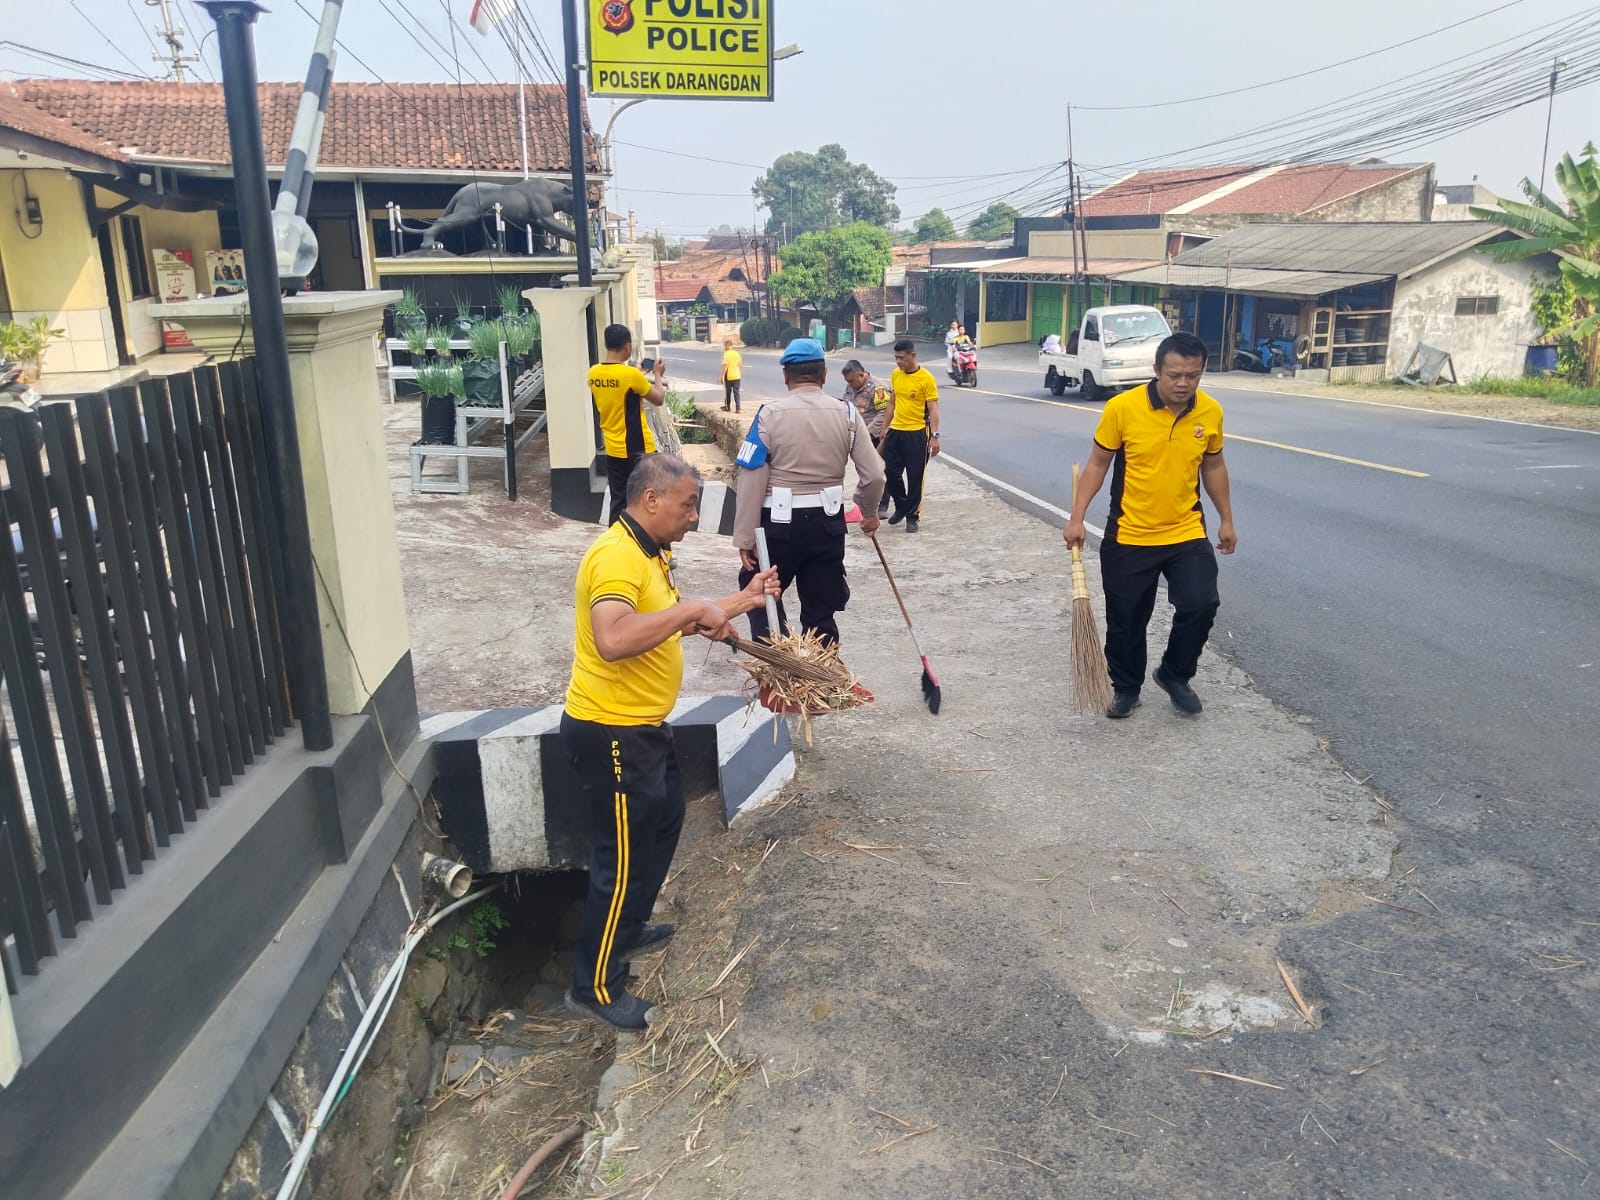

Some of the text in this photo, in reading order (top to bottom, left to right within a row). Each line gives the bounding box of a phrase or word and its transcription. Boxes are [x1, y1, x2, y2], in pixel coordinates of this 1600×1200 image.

[647, 26, 760, 53] POLICE
[599, 70, 761, 92] POLSEK DARANGDAN
[588, 379, 619, 388] POLISI
[611, 740, 622, 783] POLRI
